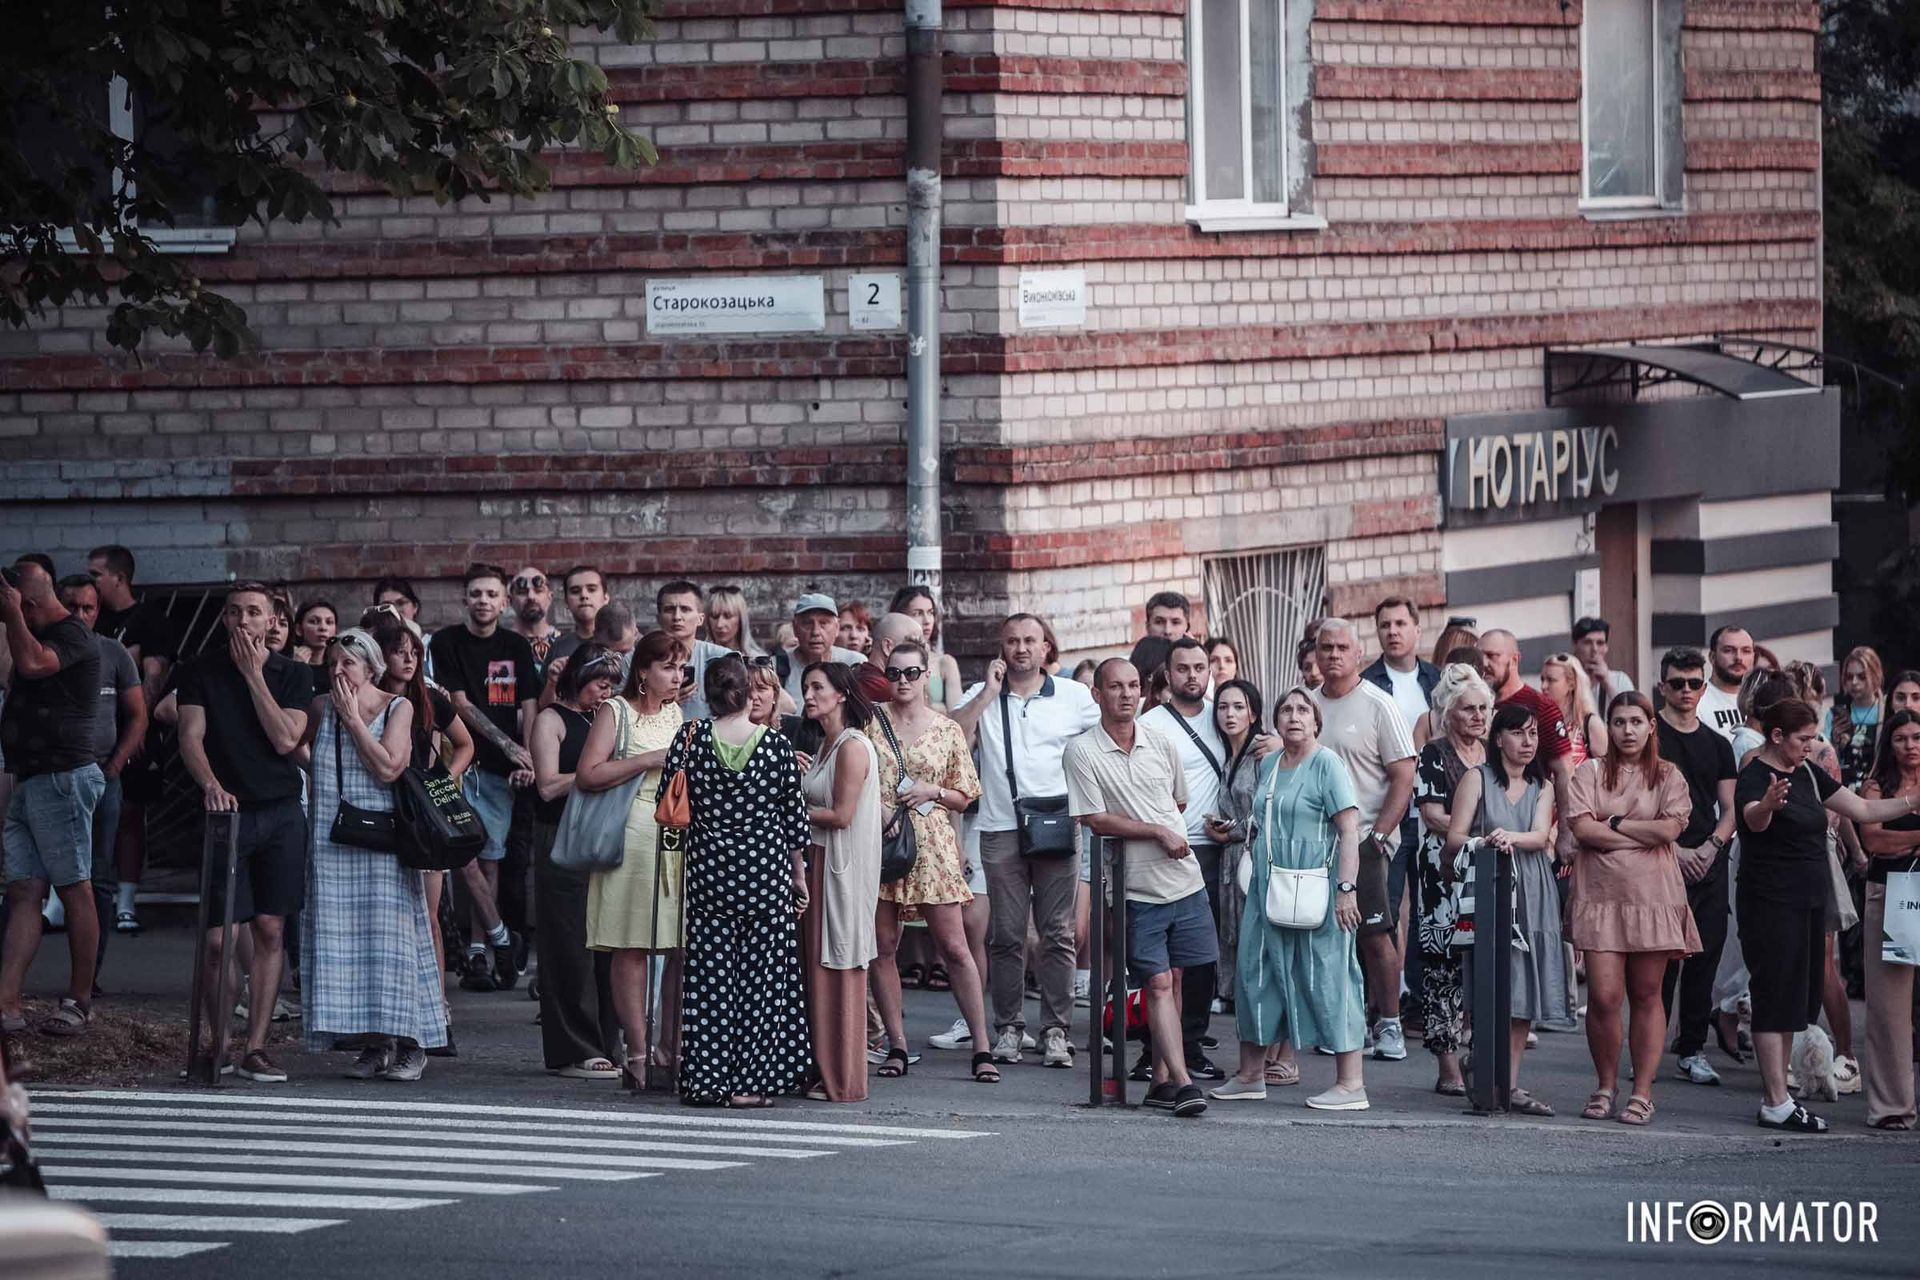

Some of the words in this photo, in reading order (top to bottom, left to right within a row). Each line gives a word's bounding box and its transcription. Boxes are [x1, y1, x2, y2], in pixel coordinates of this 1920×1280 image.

[653, 295, 775, 312] Старокозацька
[867, 283, 880, 305] 2
[1468, 426, 1620, 510] НОТАРІУС
